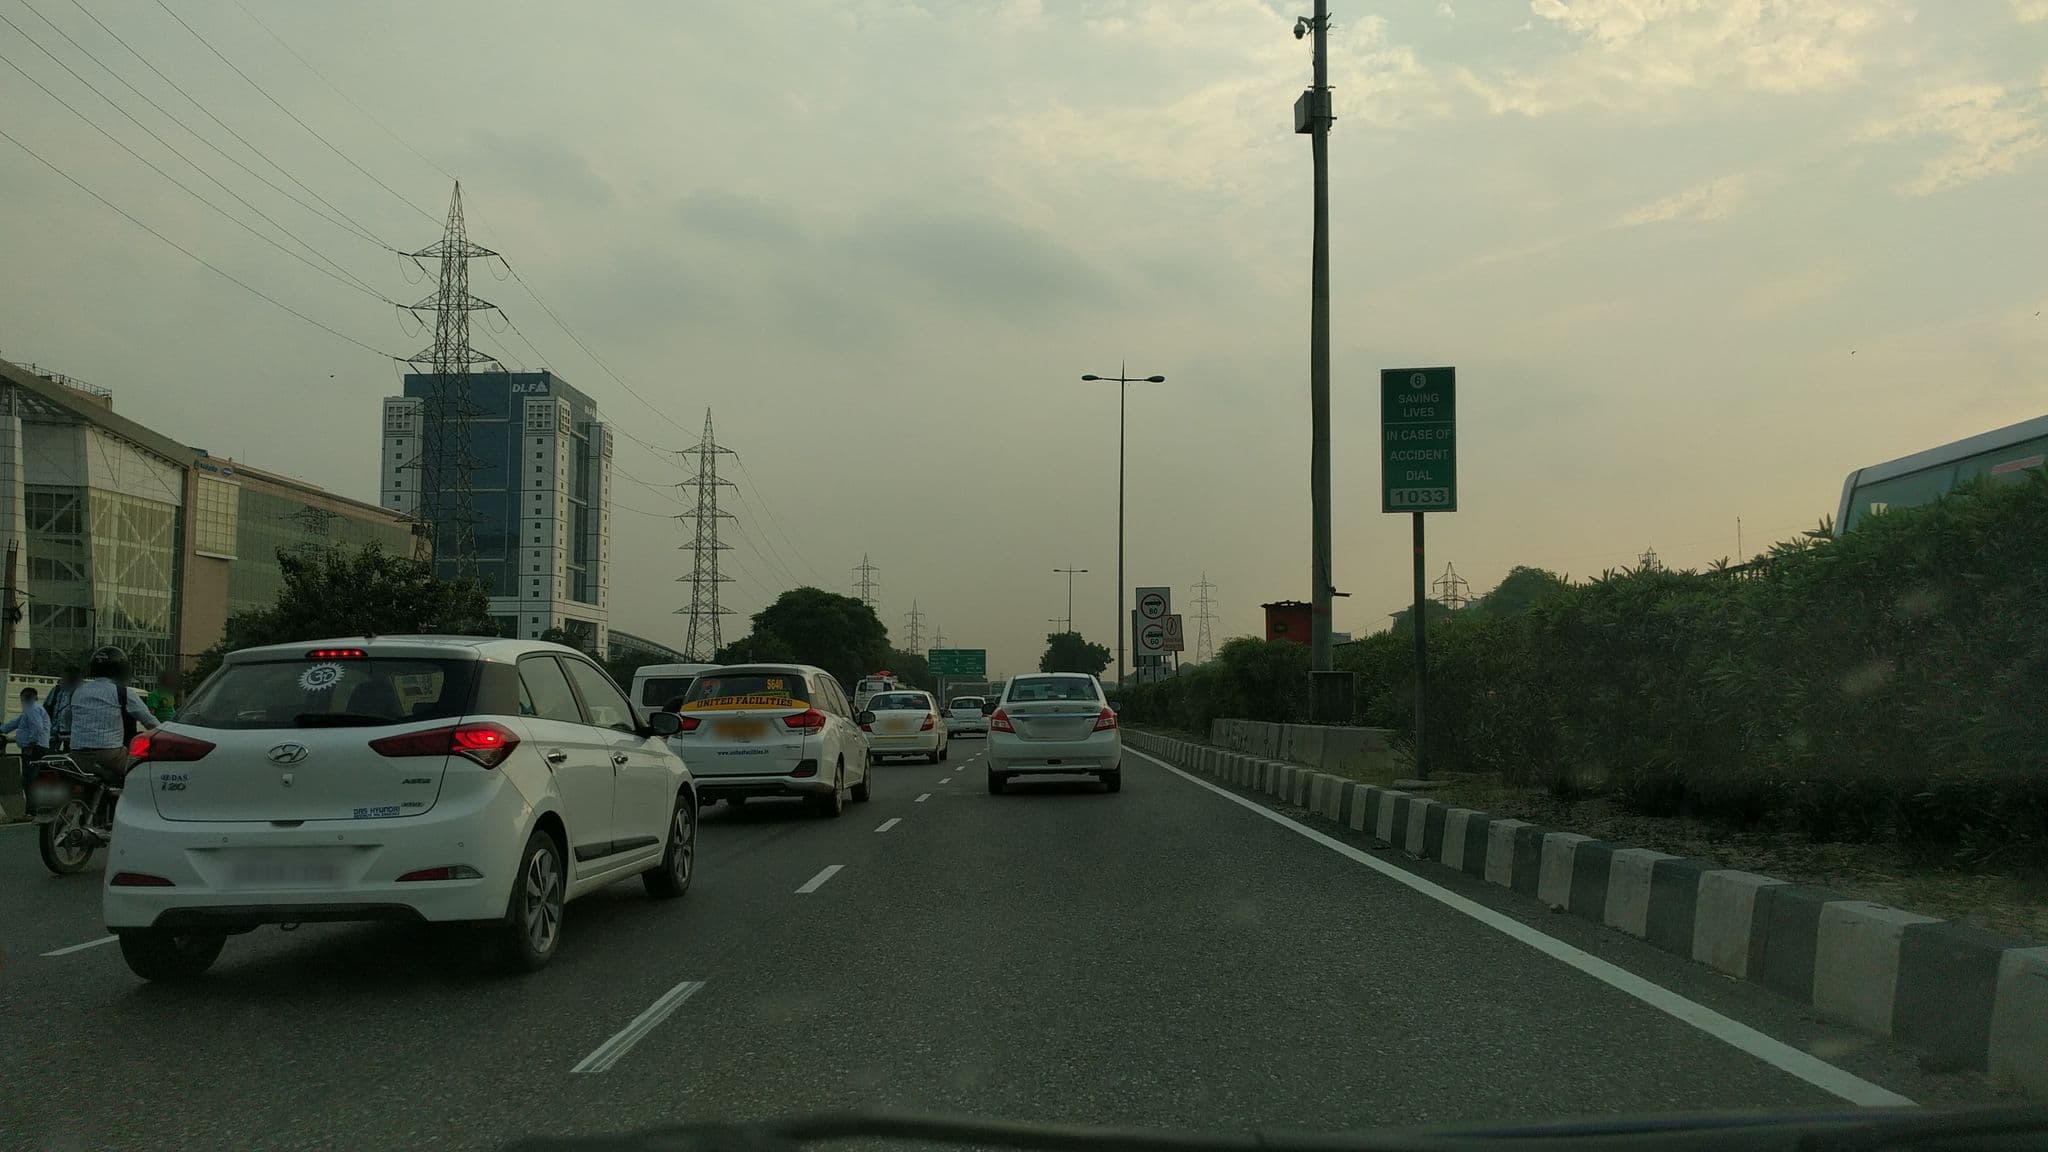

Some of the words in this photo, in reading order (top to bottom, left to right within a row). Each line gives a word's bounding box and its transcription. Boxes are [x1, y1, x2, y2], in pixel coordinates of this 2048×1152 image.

[512, 383, 537, 393] DLF
[1398, 393, 1440, 404] SAVING
[1403, 406, 1435, 418] LIVES
[1387, 430, 1398, 441] IN
[1401, 429, 1433, 441] CASE
[1436, 428, 1451, 440] OF
[1390, 449, 1449, 461] ACCIDENT
[1406, 470, 1433, 481] DIAL
[1395, 489, 1446, 504] 1033
[1150, 638, 1159, 646] 60
[697, 697, 733, 708] UNITED
[735, 696, 793, 707] FACILITIES
[171, 774, 188, 782] DAS
